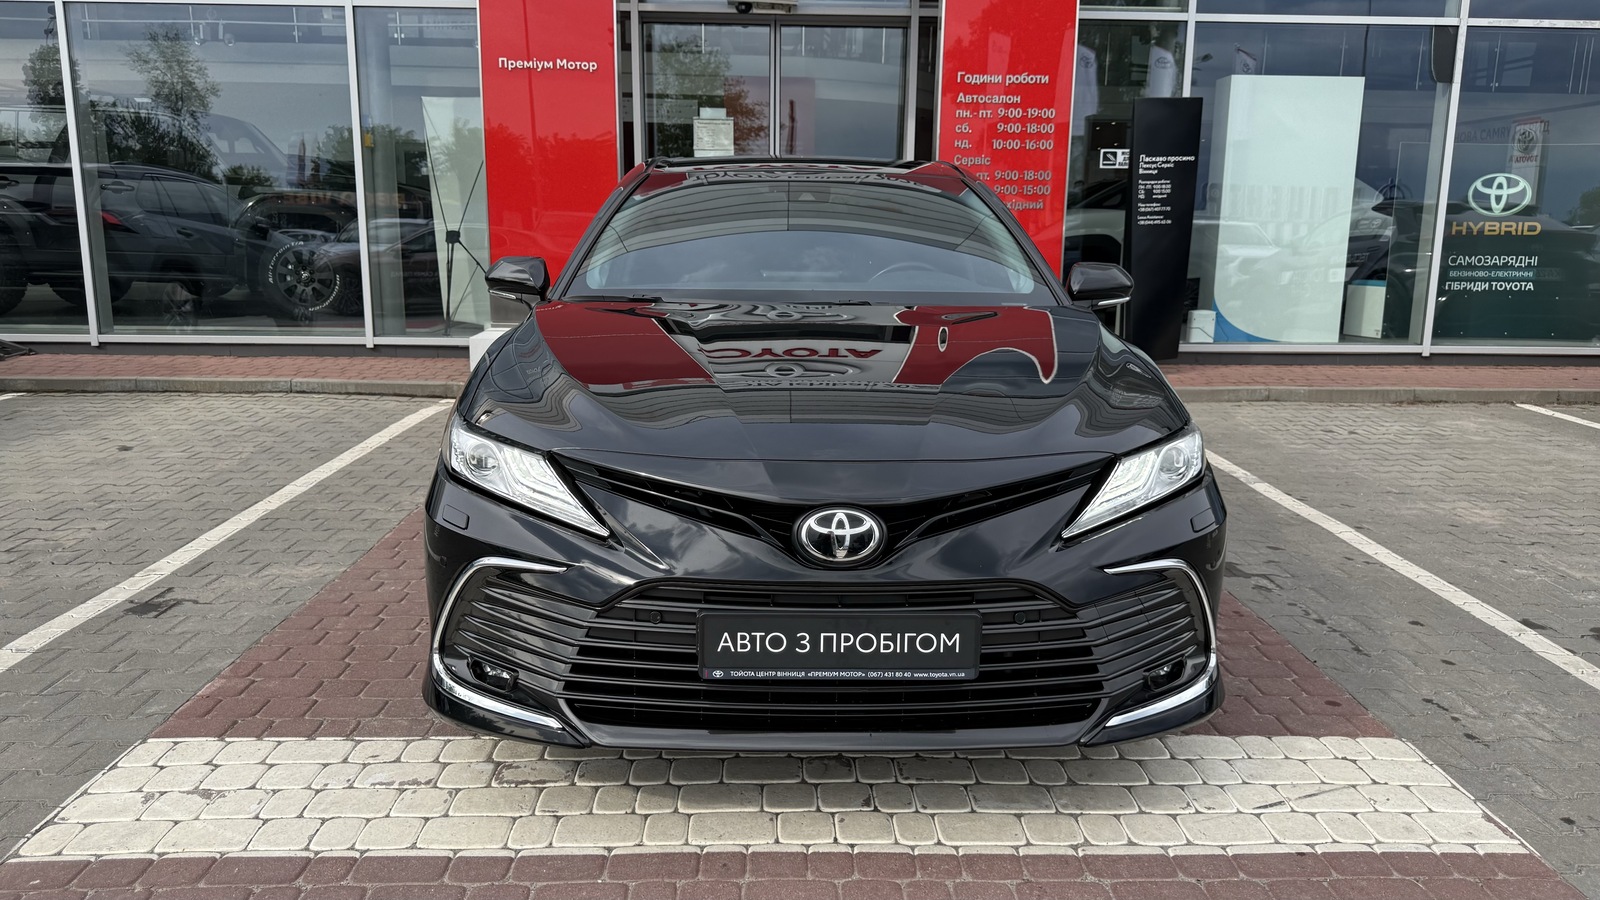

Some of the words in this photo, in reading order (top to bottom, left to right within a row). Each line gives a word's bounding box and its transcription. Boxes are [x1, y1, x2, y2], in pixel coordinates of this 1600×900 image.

[498, 57, 553, 72] Преміум
[556, 58, 598, 73] Мотор
[957, 71, 1002, 85] Години
[1005, 72, 1049, 86] роботи
[956, 92, 1021, 104] Автосалон
[997, 107, 1056, 119] 9:00-19:00
[955, 123, 972, 133] сб.
[996, 122, 1055, 134] 9:00-18:00
[954, 139, 972, 149] нд.
[992, 139, 1054, 150] 10:00-16:00
[954, 154, 991, 167] Сервіс
[1167, 155, 1195, 163] просимо
[994, 170, 1052, 181] 9:00-18:00
[993, 184, 1051, 195] 9:00-15:00
[1007, 199, 1044, 211] хідний
[1451, 221, 1541, 236] HYBRID
[1448, 255, 1538, 268] САМОЗАРЯДНІ
[1449, 270, 1533, 278] БЕНЗИНОВО-ЕЛЕКТРИЧНІ
[1445, 281, 1489, 292] ГІБРИДИ
[1490, 281, 1534, 291] TOYOTA
[717, 632, 787, 653] АВТО
[795, 632, 811, 653] З
[820, 632, 960, 653] ПРОБІГОМ
